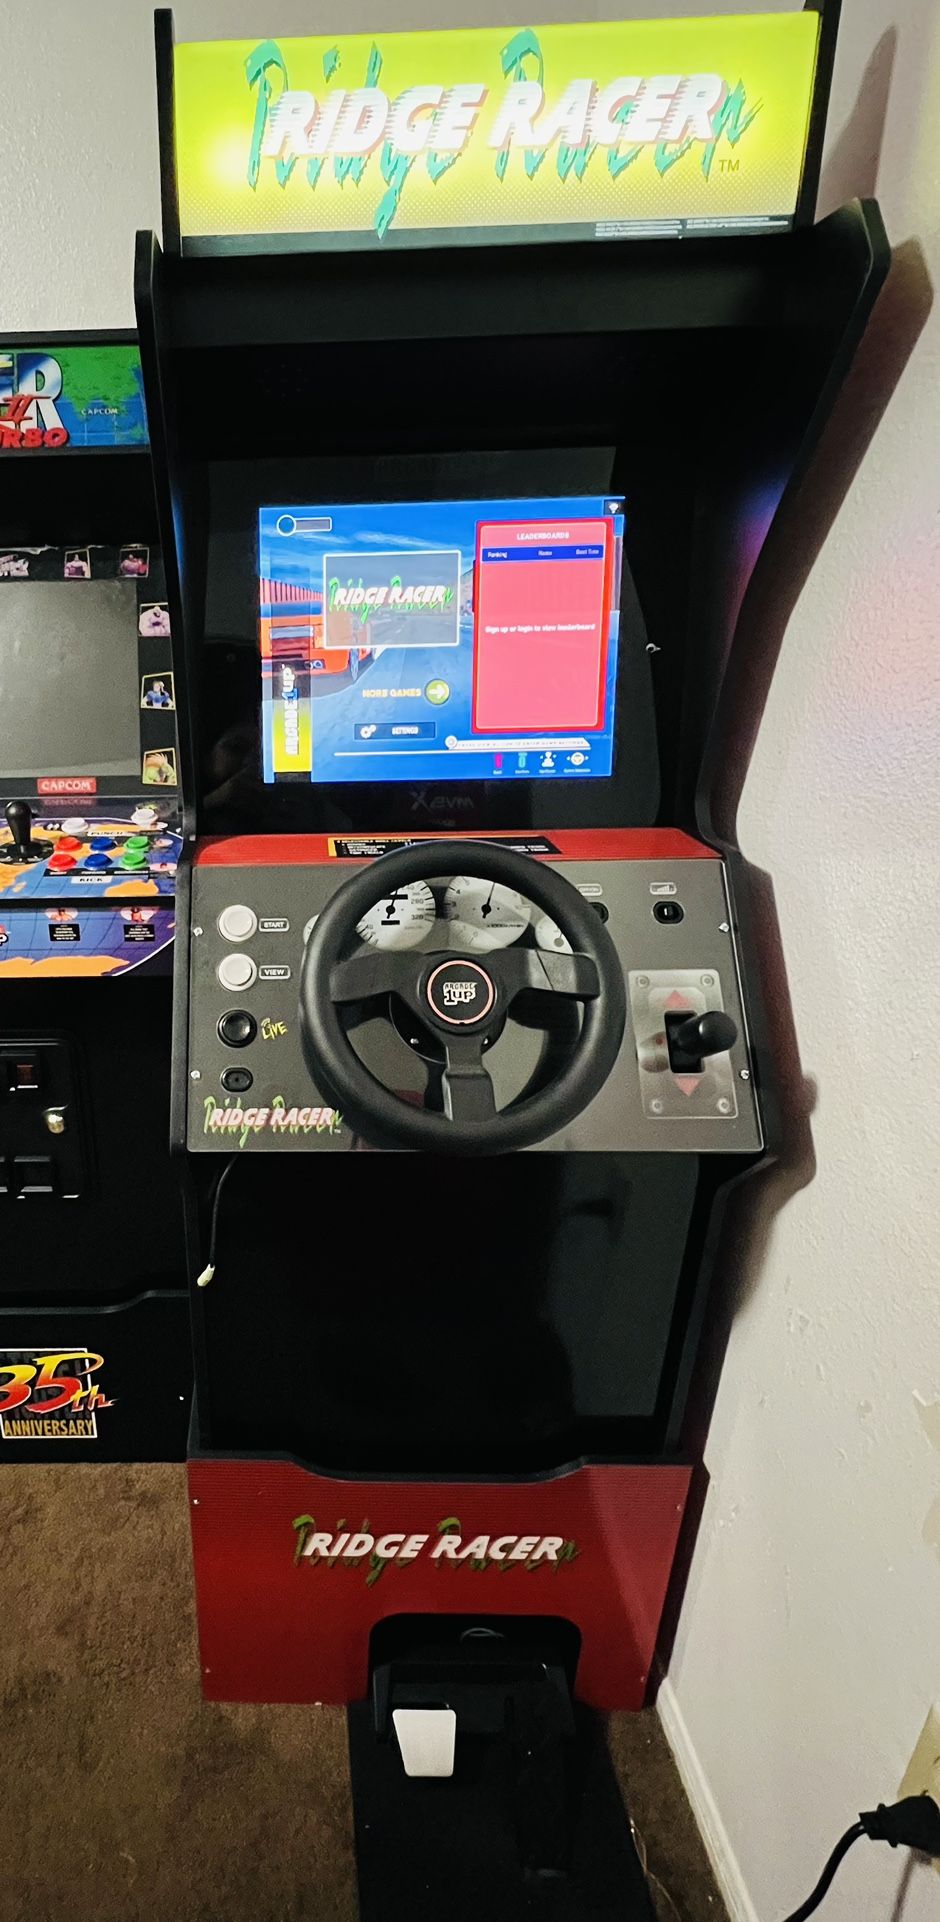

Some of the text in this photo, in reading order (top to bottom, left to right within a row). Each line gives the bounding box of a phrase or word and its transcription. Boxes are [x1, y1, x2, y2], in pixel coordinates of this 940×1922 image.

[261, 73, 728, 160] RIDGE RACER
[719, 159, 740, 173] TM
[81, 407, 119, 415] CAPCOM
[0, 424, 69, 448] RBO
[516, 532, 570, 540] LEADERBOARDS
[333, 585, 446, 605] RIDGE RACER
[485, 626, 500, 634] Sign
[501, 626, 509, 634] up
[557, 623, 596, 631] leaderboard
[362, 687, 421, 698] MORE GAMES
[391, 726, 419, 735] SETTINGS
[41, 780, 91, 790] CAPCOM
[263, 921, 285, 929] START
[261, 1020, 288, 1041] LIVE
[209, 1107, 335, 1127] RIDGE RACER
[4, 1419, 94, 1437] ANNIVERSARY
[303, 1532, 564, 1561] RIDGE RACER
